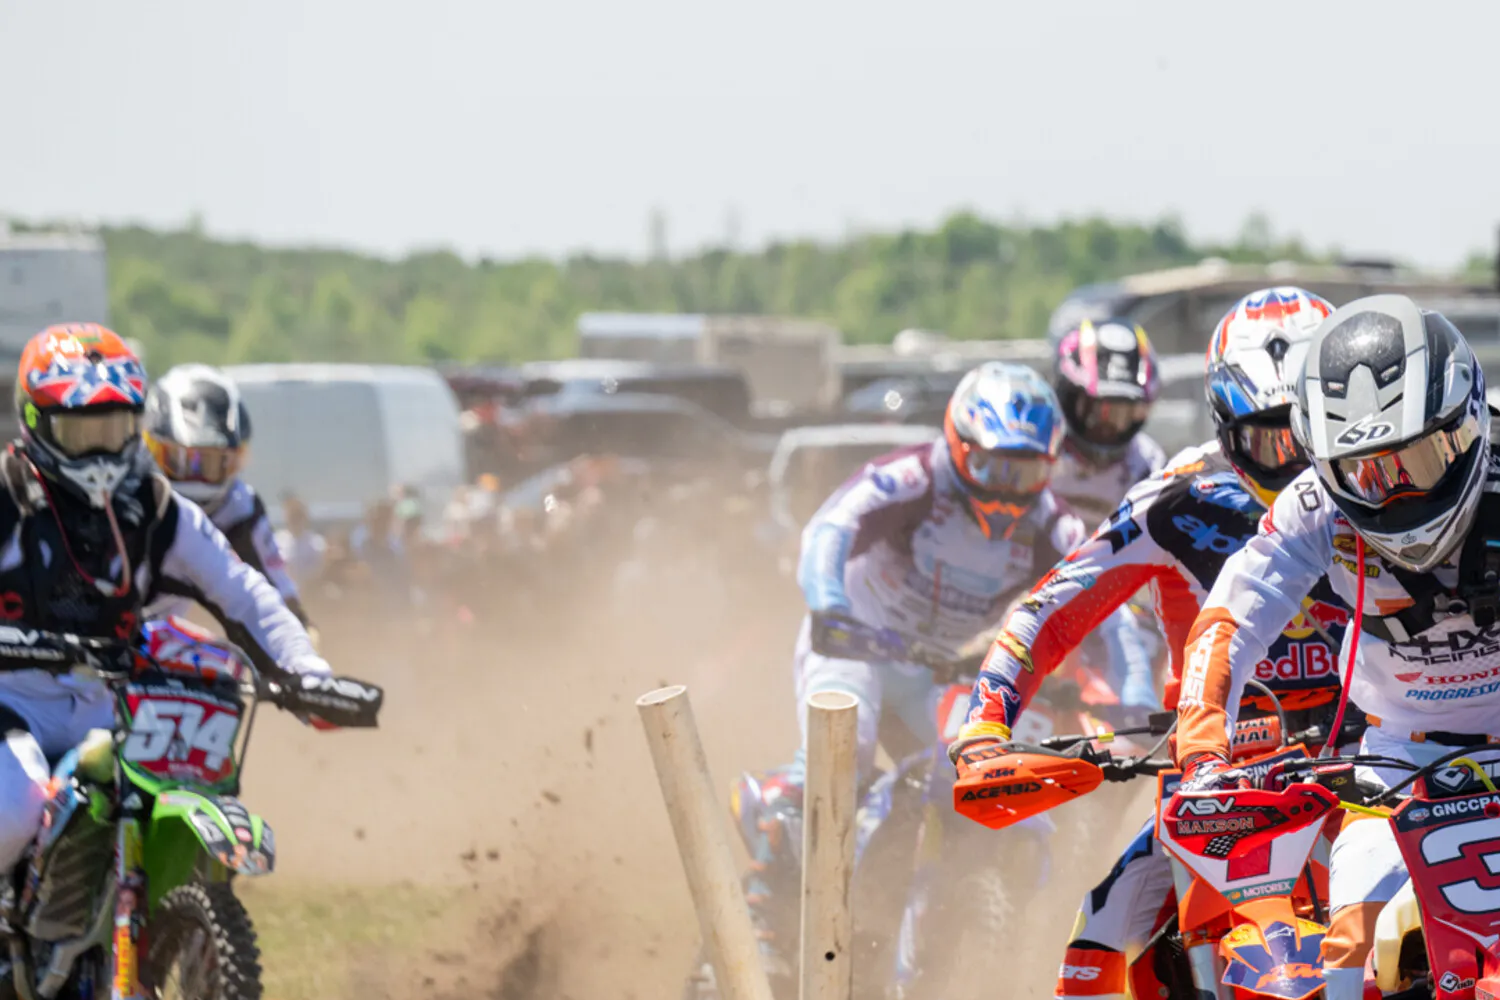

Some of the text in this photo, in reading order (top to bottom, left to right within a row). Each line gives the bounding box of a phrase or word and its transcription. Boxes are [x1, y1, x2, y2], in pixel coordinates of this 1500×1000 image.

[124, 700, 239, 772] 514
[961, 781, 1042, 802] ACERBIS
[1176, 797, 1236, 817] ASV
[1176, 816, 1256, 836] MAKSON
[1242, 879, 1293, 898] MOTOREX
